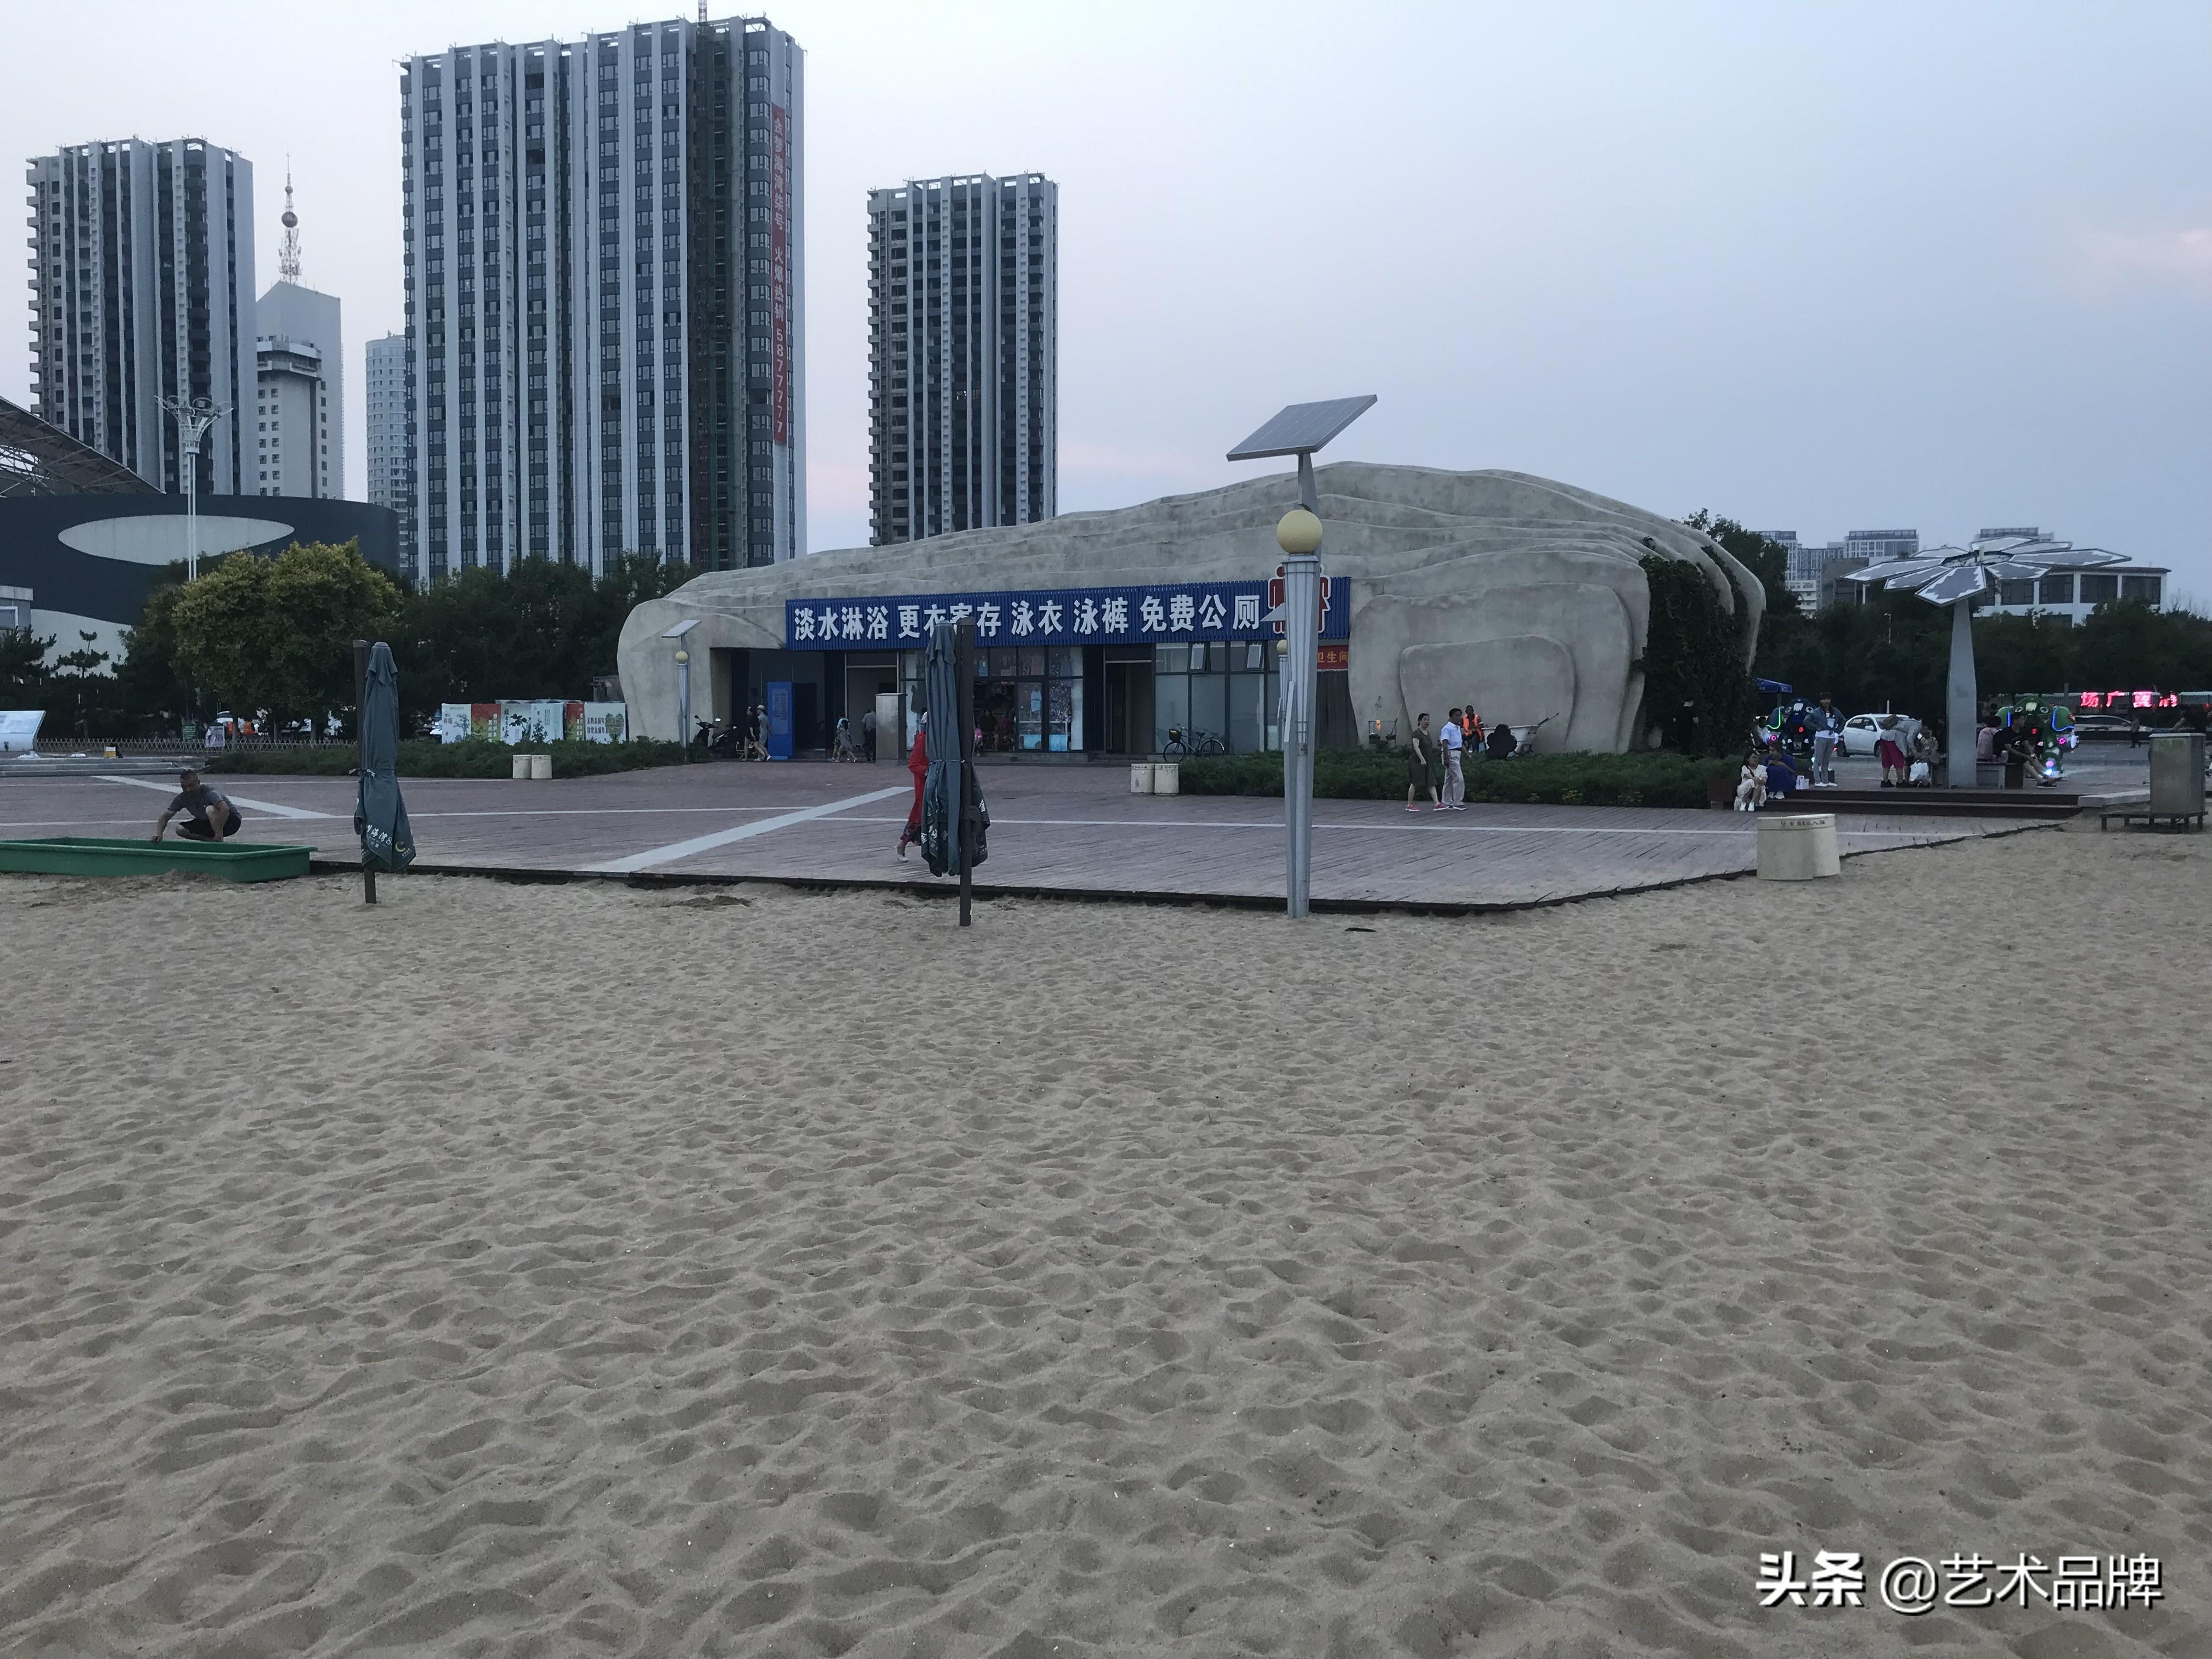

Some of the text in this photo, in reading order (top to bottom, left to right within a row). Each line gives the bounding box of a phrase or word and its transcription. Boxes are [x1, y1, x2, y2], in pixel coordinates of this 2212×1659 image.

[794, 606, 889, 641] 淡水淋浴
[1011, 597, 1063, 636] 泳衣
[1073, 596, 1128, 635] 泳裤
[1140, 594, 1260, 633] 免费公厕
